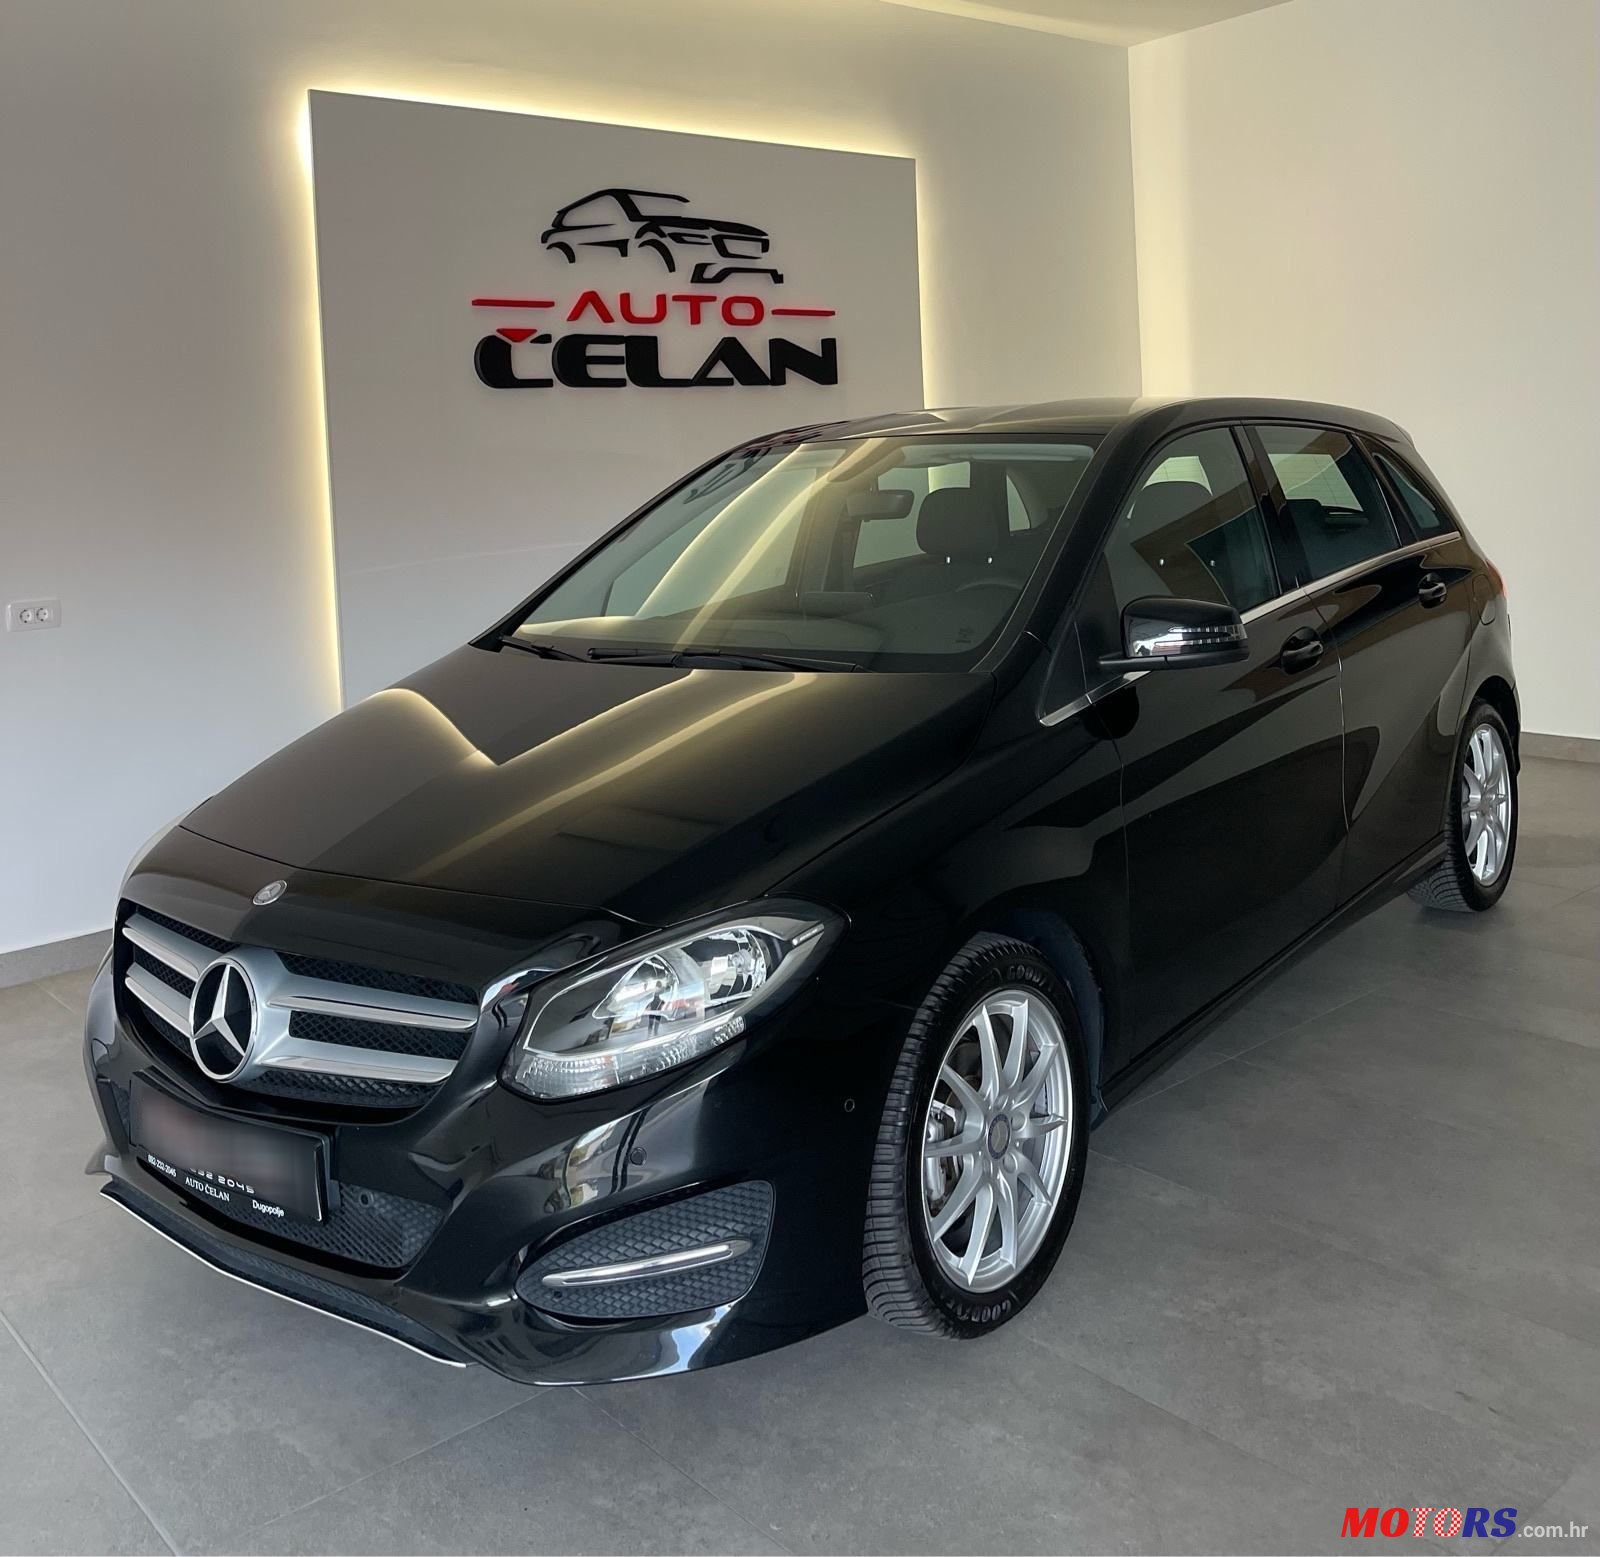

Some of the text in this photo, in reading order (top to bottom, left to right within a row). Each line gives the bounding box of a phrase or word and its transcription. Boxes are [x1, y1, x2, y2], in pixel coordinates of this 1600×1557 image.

[567, 290, 765, 327] AUTO
[474, 327, 838, 389] ČELAN
[185, 1176, 204, 1192] AUTO
